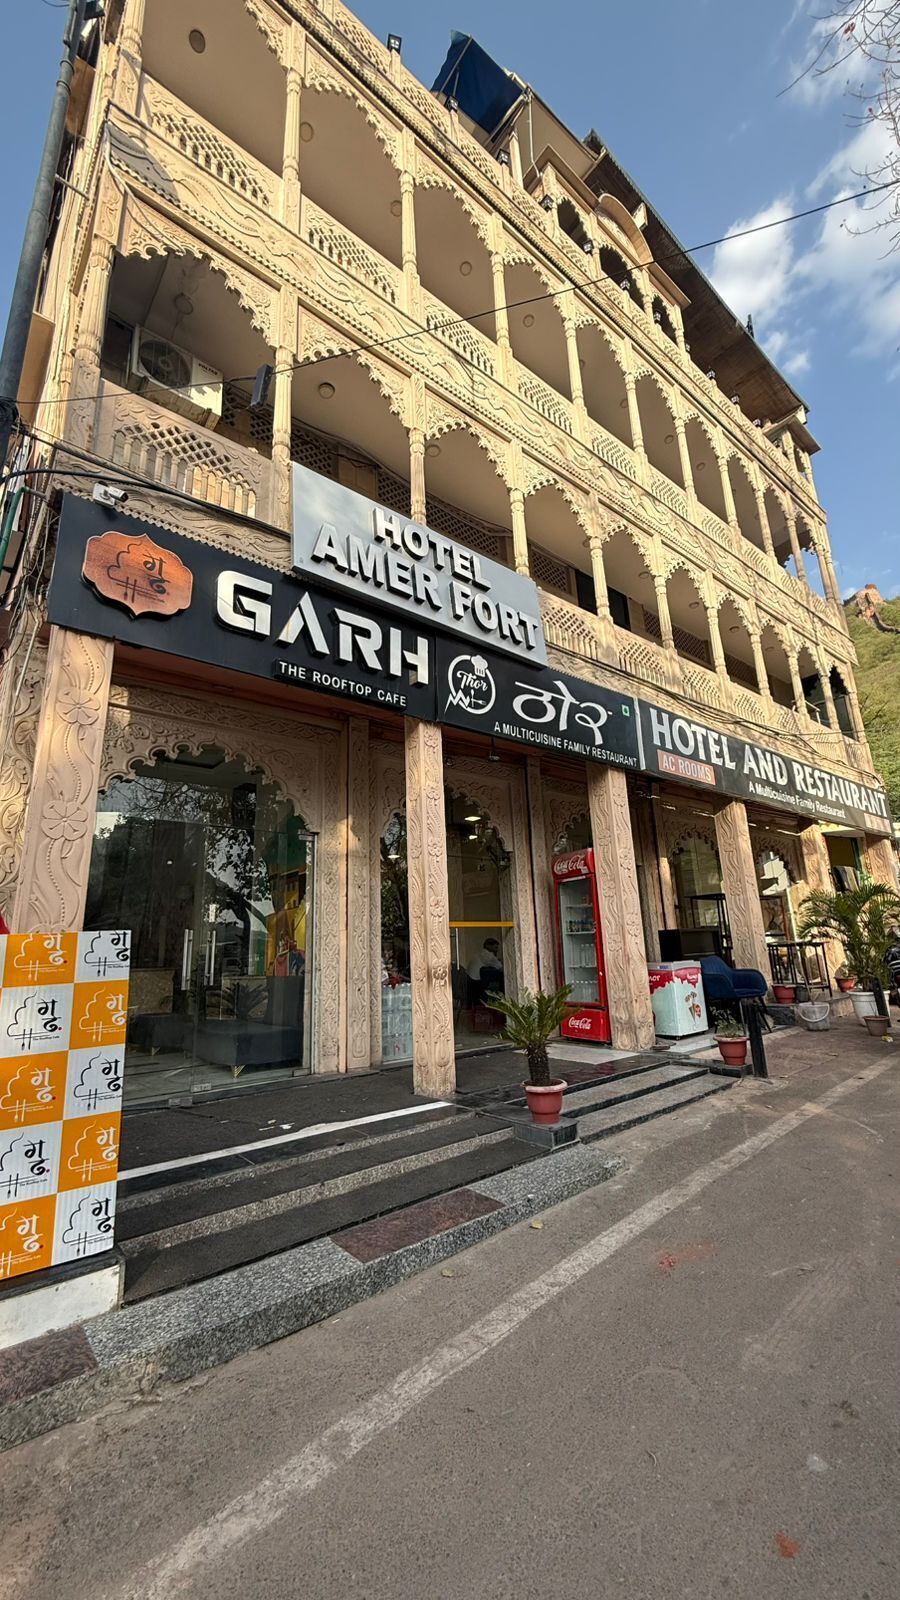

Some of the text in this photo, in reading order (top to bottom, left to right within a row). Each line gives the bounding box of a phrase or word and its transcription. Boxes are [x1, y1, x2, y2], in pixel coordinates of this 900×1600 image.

[373, 507, 491, 592] HOTEL
[311, 522, 538, 650] AMER FORT
[216, 570, 429, 686] GARH
[279, 661, 407, 707] THE ROOFTOP CAFE
[457, 670, 488, 692] Thor
[494, 721, 638, 767] A MULTICUISINE FAMILY RESTAURANT
[650, 707, 888, 818] HOTEL AND RESTAURANT
[662, 756, 712, 783] AC ROOMS
[749, 781, 755, 793] A
[796, 795, 815, 812] Family
[815, 801, 846, 818] Restaurant
